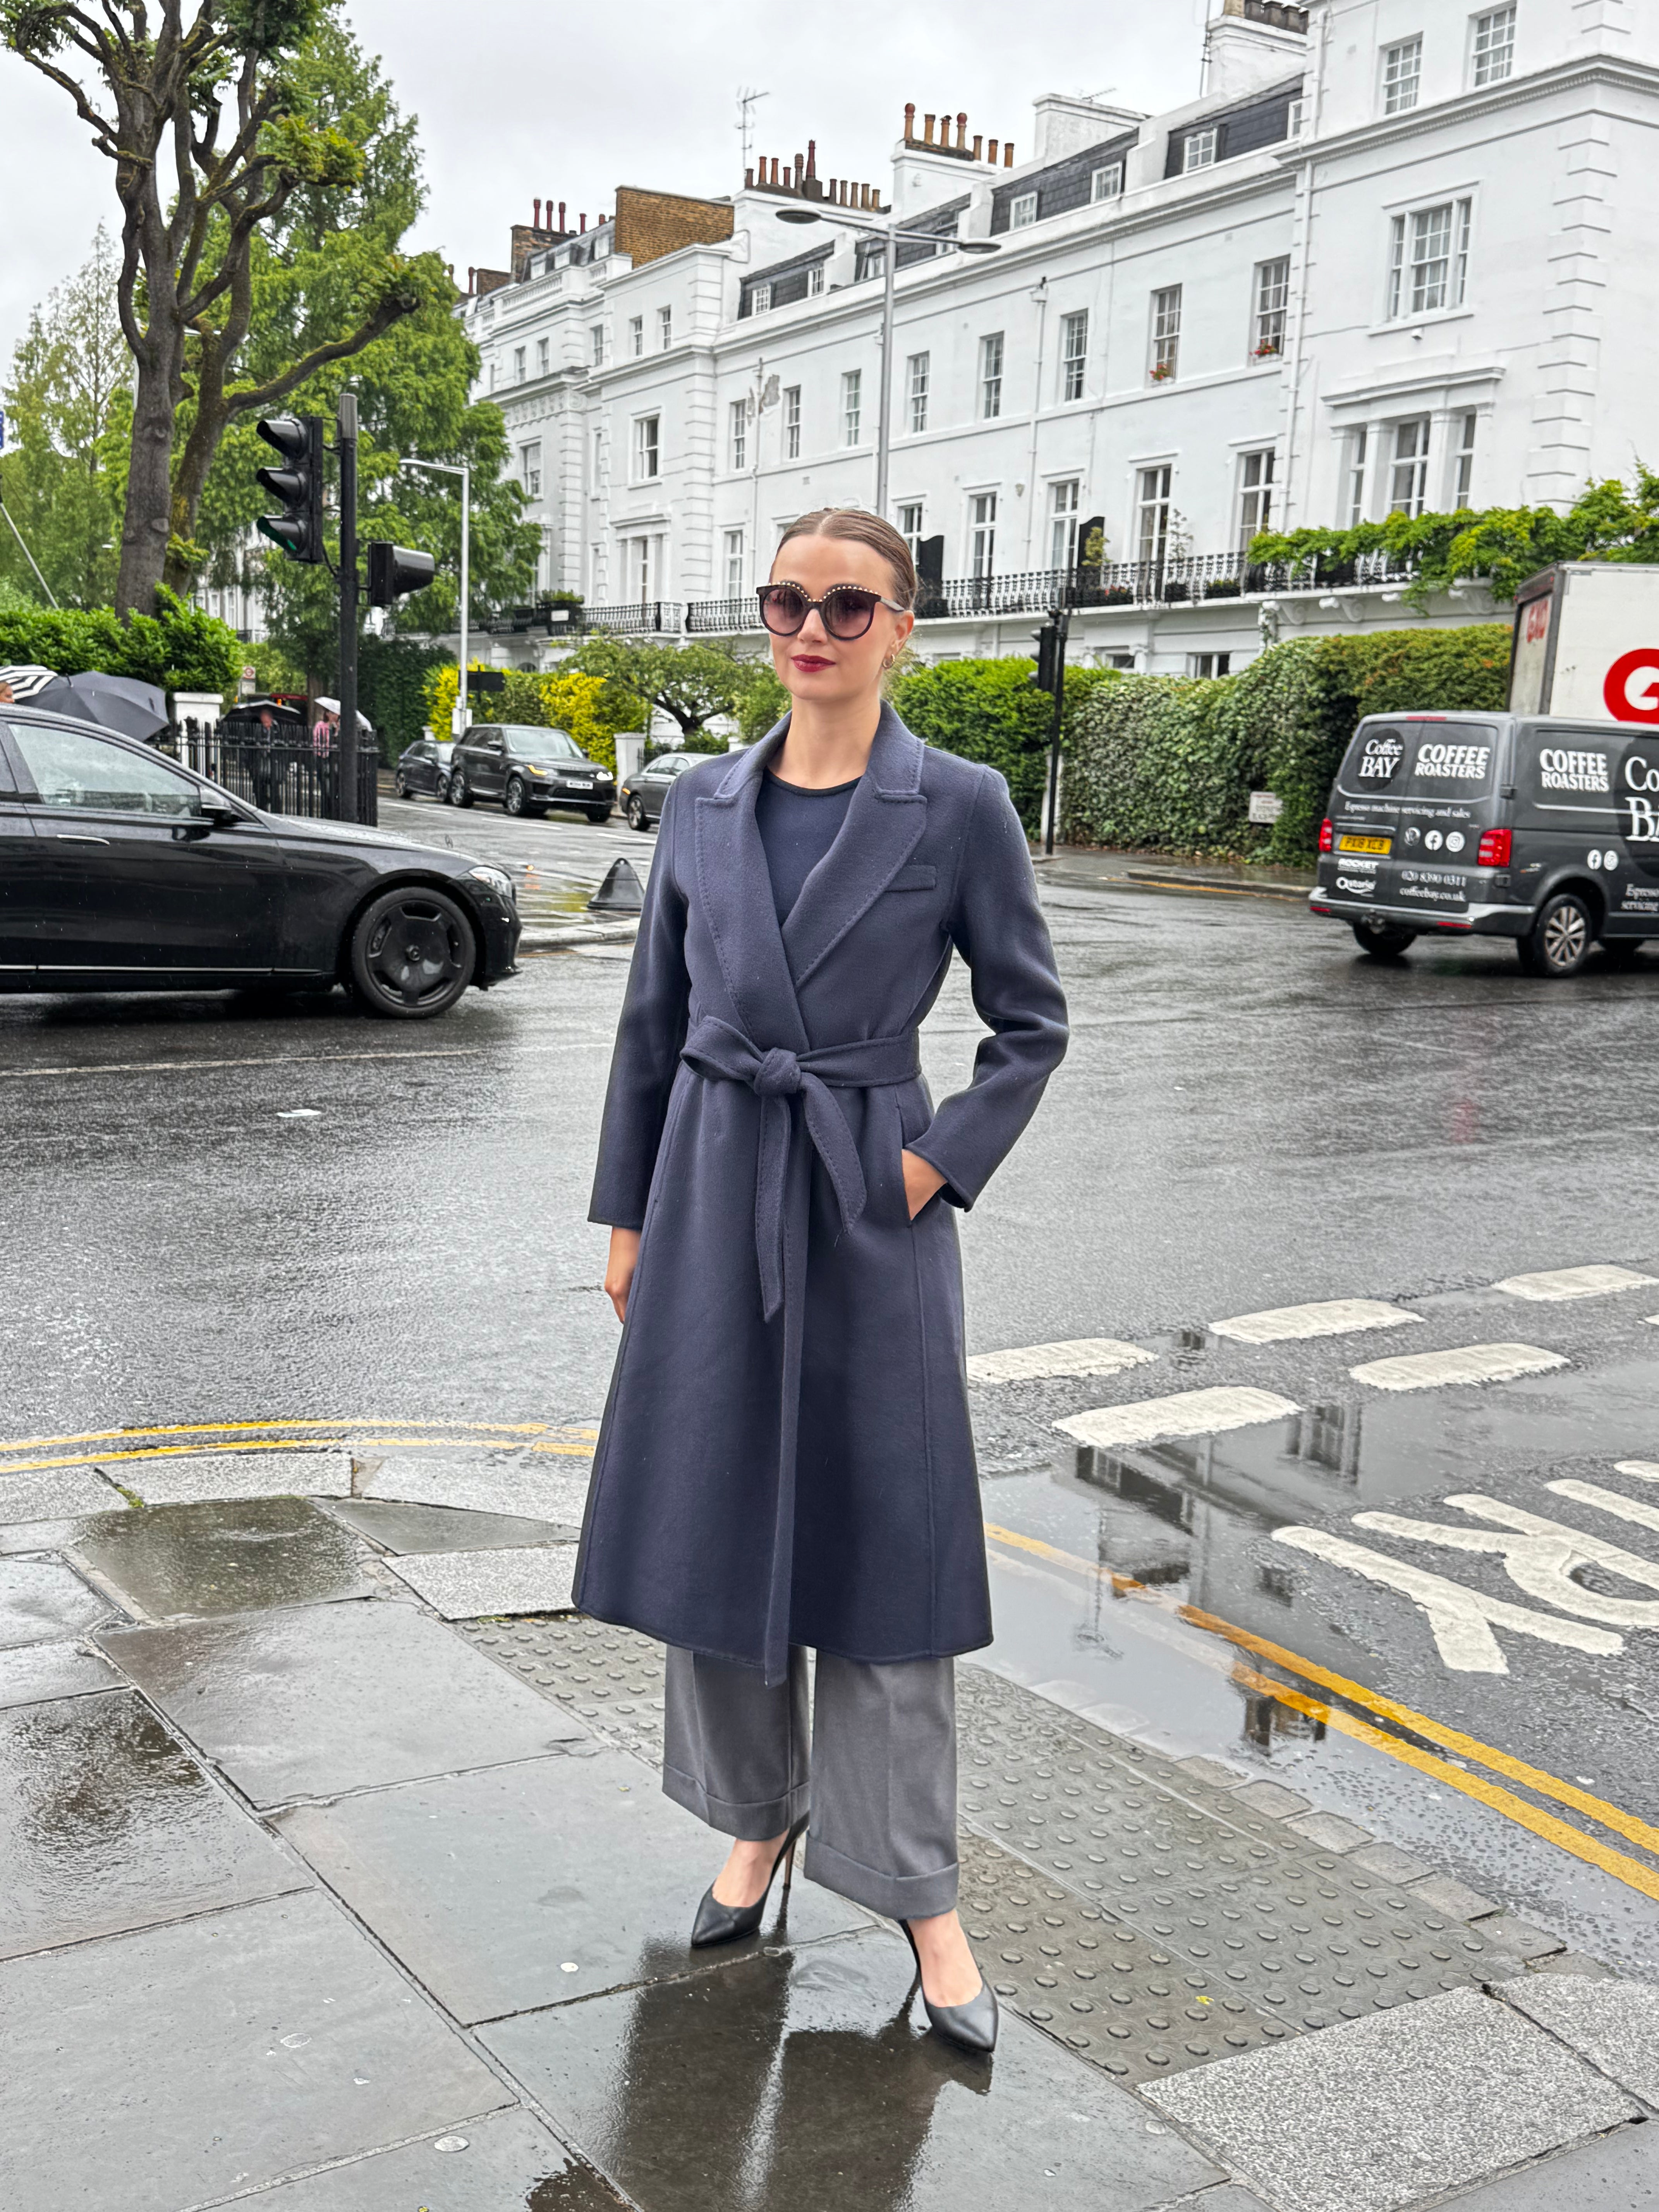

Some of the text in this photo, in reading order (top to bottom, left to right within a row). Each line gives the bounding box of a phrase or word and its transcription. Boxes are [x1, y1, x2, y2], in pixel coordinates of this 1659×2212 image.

[1365, 738, 1403, 756] Coffee
[1417, 744, 1491, 765] COFFEE
[1358, 756, 1400, 778] BAY
[1415, 763, 1486, 780] ROASTERS
[1539, 749, 1608, 776] COFFEE
[1541, 771, 1609, 792] ROASTERS
[1435, 806, 1452, 817] and
[1452, 807, 1471, 818] sales
[1401, 870, 1419, 882] 020
[1400, 885, 1466, 902] coffeebay.co.uk
